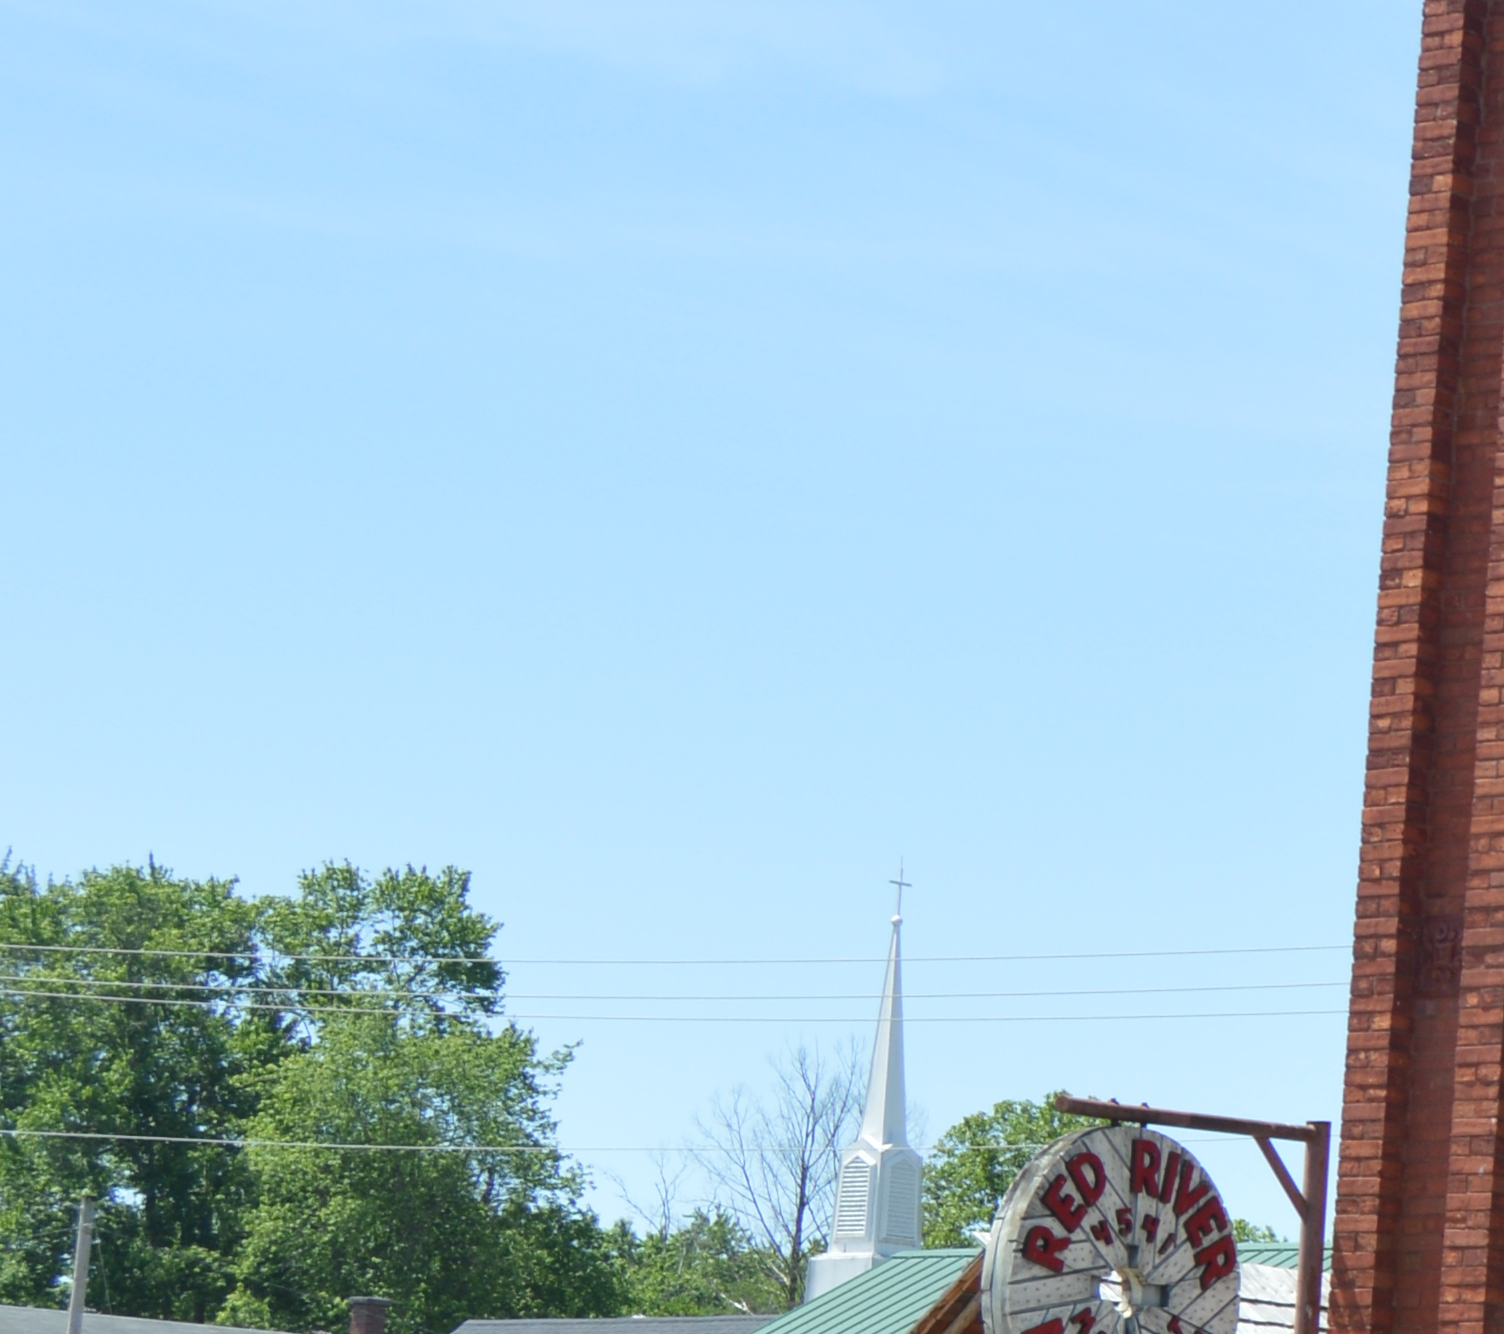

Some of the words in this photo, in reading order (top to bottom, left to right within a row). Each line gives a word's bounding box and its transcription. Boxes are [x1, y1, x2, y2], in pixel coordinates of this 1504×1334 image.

[1022, 1152, 1107, 1273] RED
[1131, 1139, 1236, 1290] RIVER
[1091, 1208, 1176, 1256] 4541
